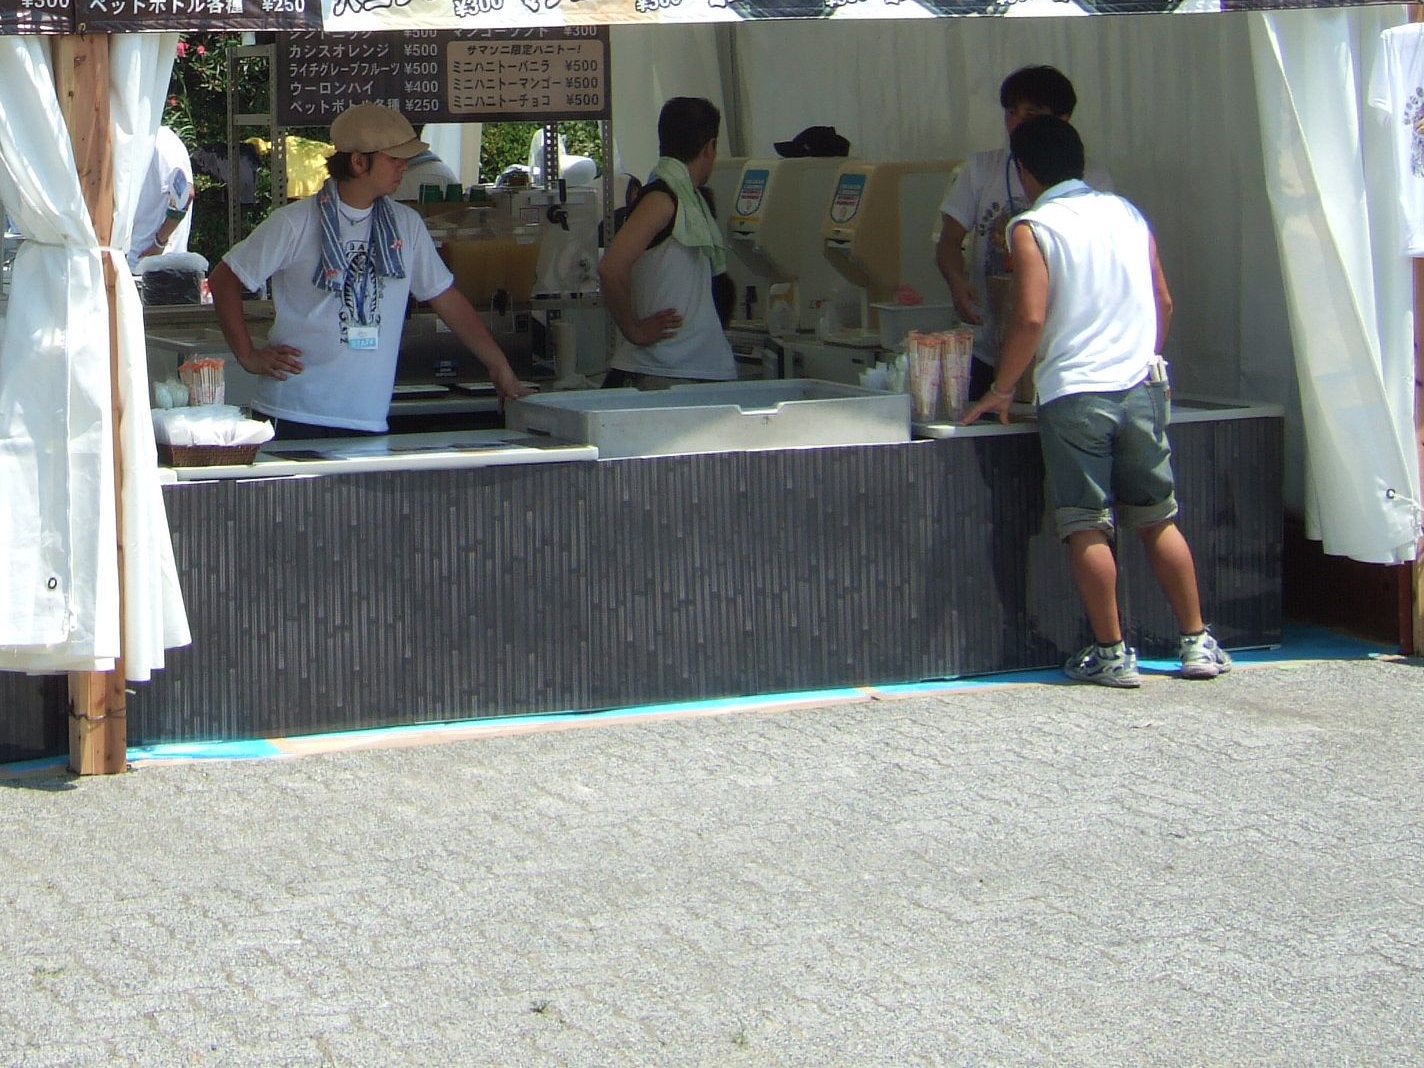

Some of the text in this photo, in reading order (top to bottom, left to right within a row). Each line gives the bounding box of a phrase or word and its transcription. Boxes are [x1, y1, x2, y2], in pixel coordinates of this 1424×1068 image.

[289, 43, 438, 59] カシスオレンジ ¥500
[289, 61, 438, 77] ライチグレープフルーツ ¥500
[565, 59, 598, 72] ¥500
[290, 80, 439, 95] ウーロンハイ ¥400
[565, 77, 598, 90] ¥500
[405, 99, 439, 112] ¥250
[566, 94, 599, 106] ¥500
